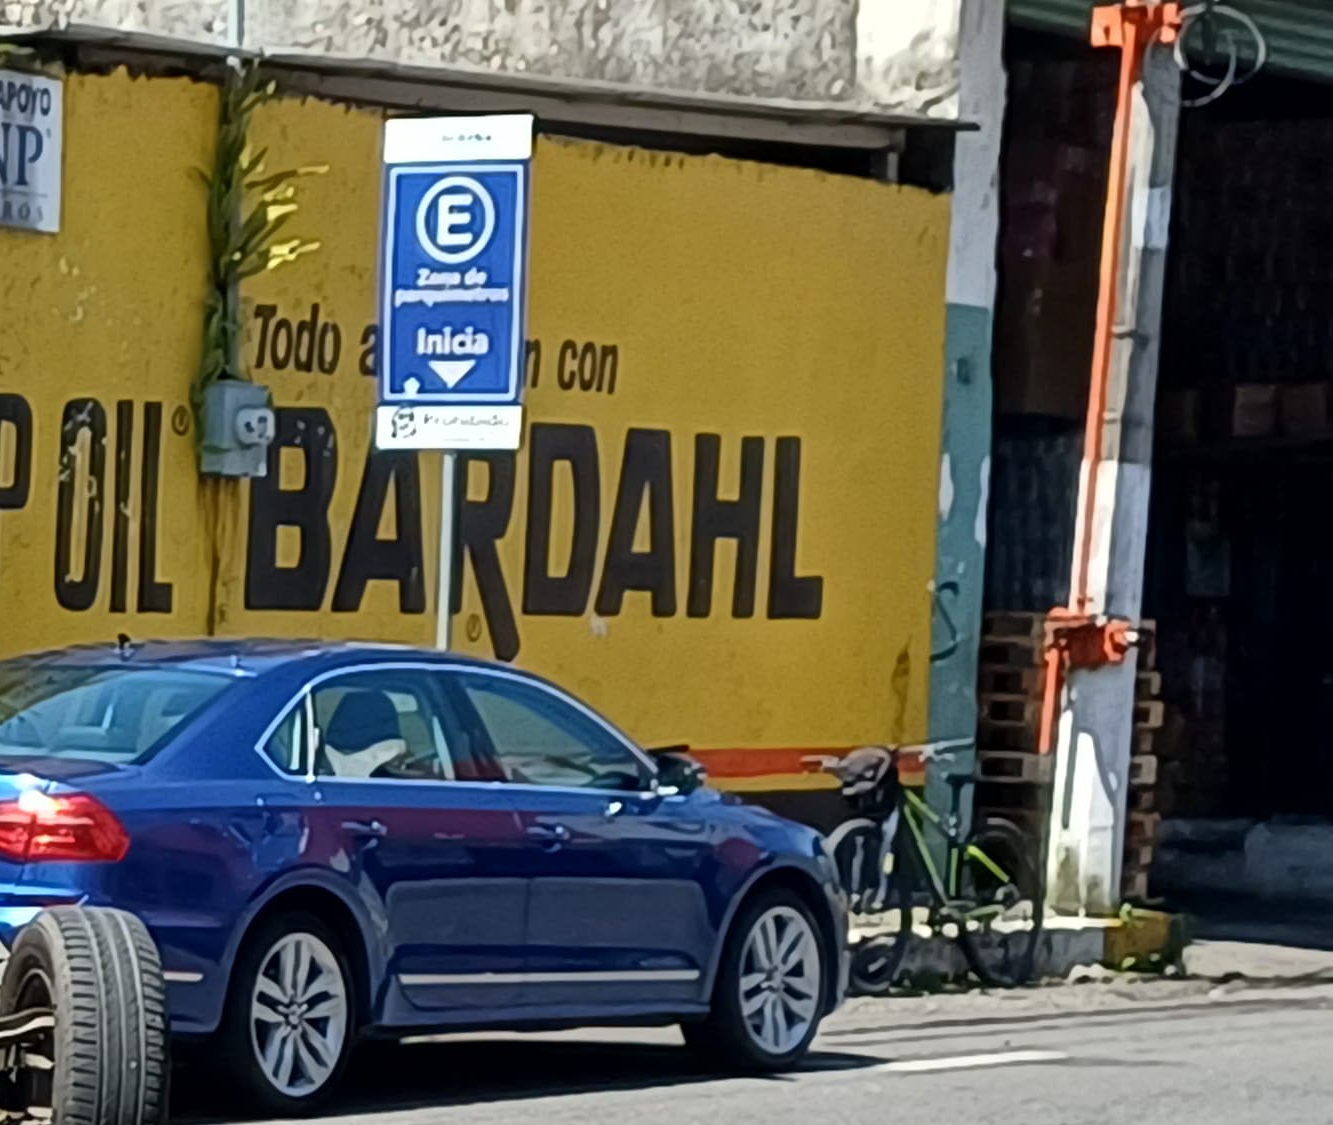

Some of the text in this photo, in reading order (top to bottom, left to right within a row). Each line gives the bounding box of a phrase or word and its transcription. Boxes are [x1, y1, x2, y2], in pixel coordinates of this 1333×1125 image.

[436, 193, 473, 246] E
[254, 303, 341, 376] Todo
[557, 339, 619, 395] con
[416, 326, 490, 355] Inicia
[244, 406, 824, 663] BARDAHL
